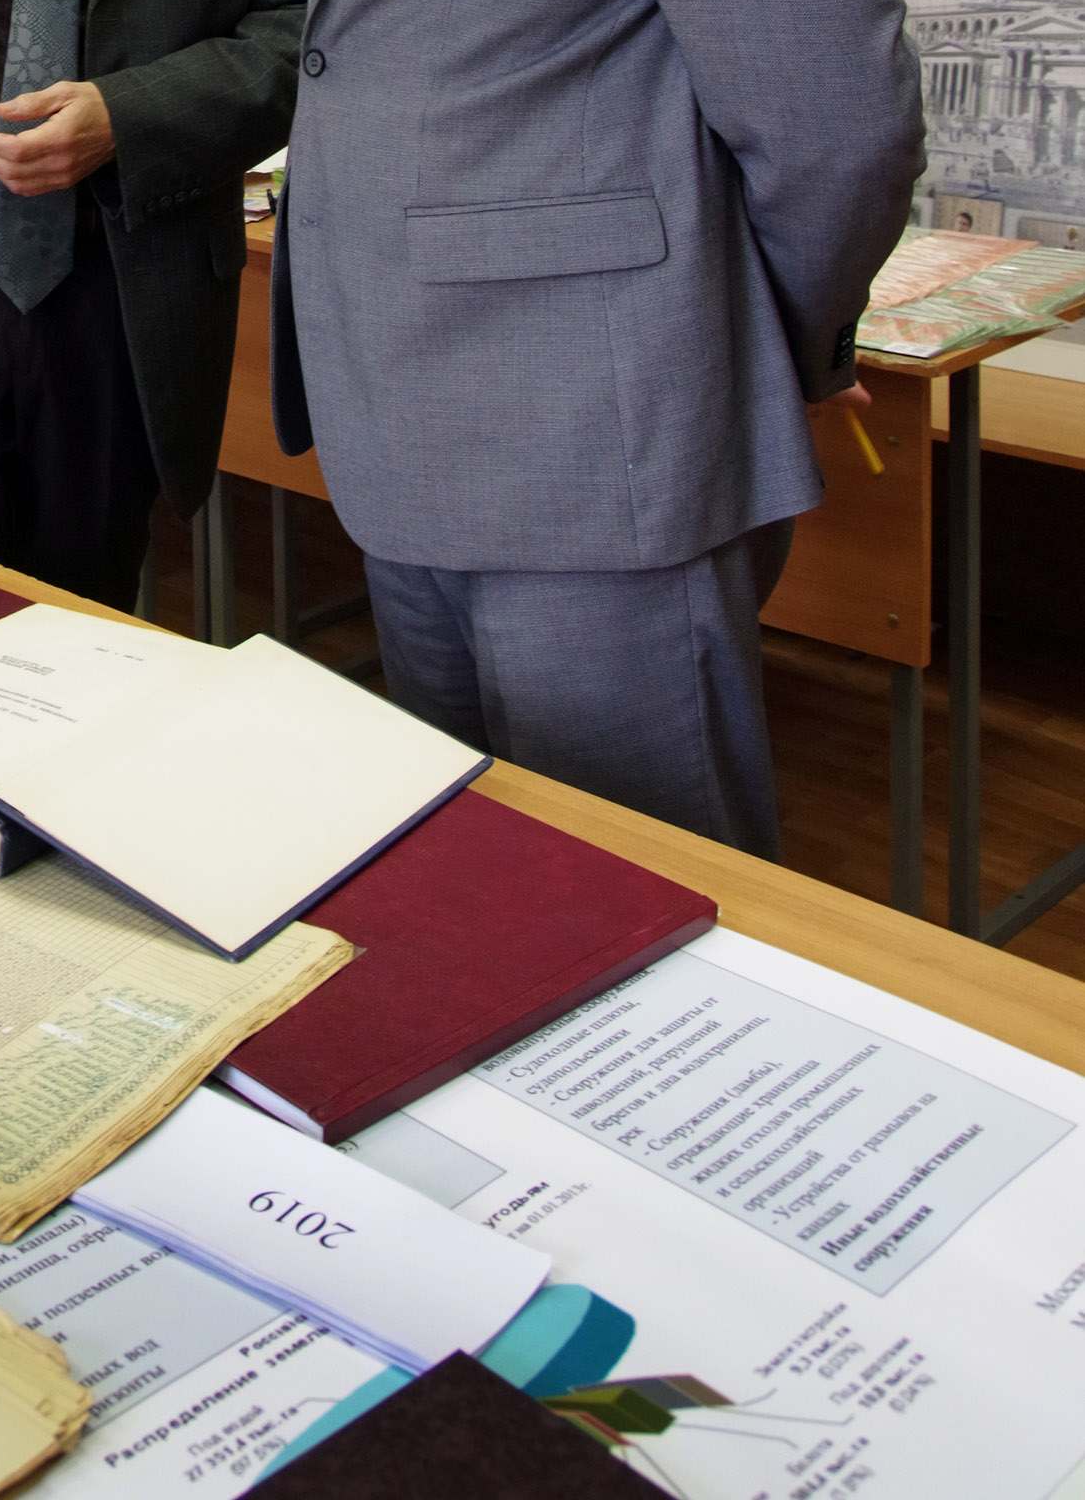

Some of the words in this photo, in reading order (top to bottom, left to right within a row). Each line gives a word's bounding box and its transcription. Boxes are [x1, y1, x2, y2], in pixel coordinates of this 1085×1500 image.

[509, 1027, 592, 1079] Судоходные
[590, 1000, 642, 1031] шлюзы,
[525, 1027, 633, 1095] судоподъемники
[553, 1049, 635, 1104] Сооружения
[635, 1035, 659, 1055] для
[654, 1005, 706, 1038] защиты
[702, 996, 719, 1009] от
[571, 1067, 653, 1120] наводнений,
[648, 1019, 722, 1070] разрушений
[591, 1096, 648, 1132] берегов
[644, 1088, 657, 1100] и
[656, 1071, 681, 1095] дна
[681, 1015, 771, 1078] водохранилищ,
[617, 1124, 644, 1148] рек
[646, 1095, 729, 1152] Сооружения
[725, 1059, 784, 1104] (дамбы),
[666, 1107, 756, 1171] ограждающие
[751, 1058, 821, 1110] хранилища
[690, 1147, 745, 1185] жидких
[741, 1108, 793, 1151] отходов
[789, 1042, 882, 1113] промышленных
[716, 1186, 731, 1199] и
[728, 1085, 865, 1192] сельскохозяйственных
[743, 1149, 825, 1214] организаций
[772, 1162, 852, 1221] Устройства
[847, 1149, 868, 1166] от
[863, 1104, 923, 1154] размывов
[916, 1091, 938, 1108] на
[819, 1221, 869, 1258] Иные
[864, 1122, 985, 1226] водохозяйственные
[17, 1213, 87, 1256] каналы)
[249, 1190, 357, 1249] 2019
[795, 1199, 851, 1243] каналах
[853, 1203, 935, 1273] сооружения
[42, 1263, 141, 1324] подземных
[123, 1338, 162, 1362] вод
[104, 1369, 259, 1469] Распределение
